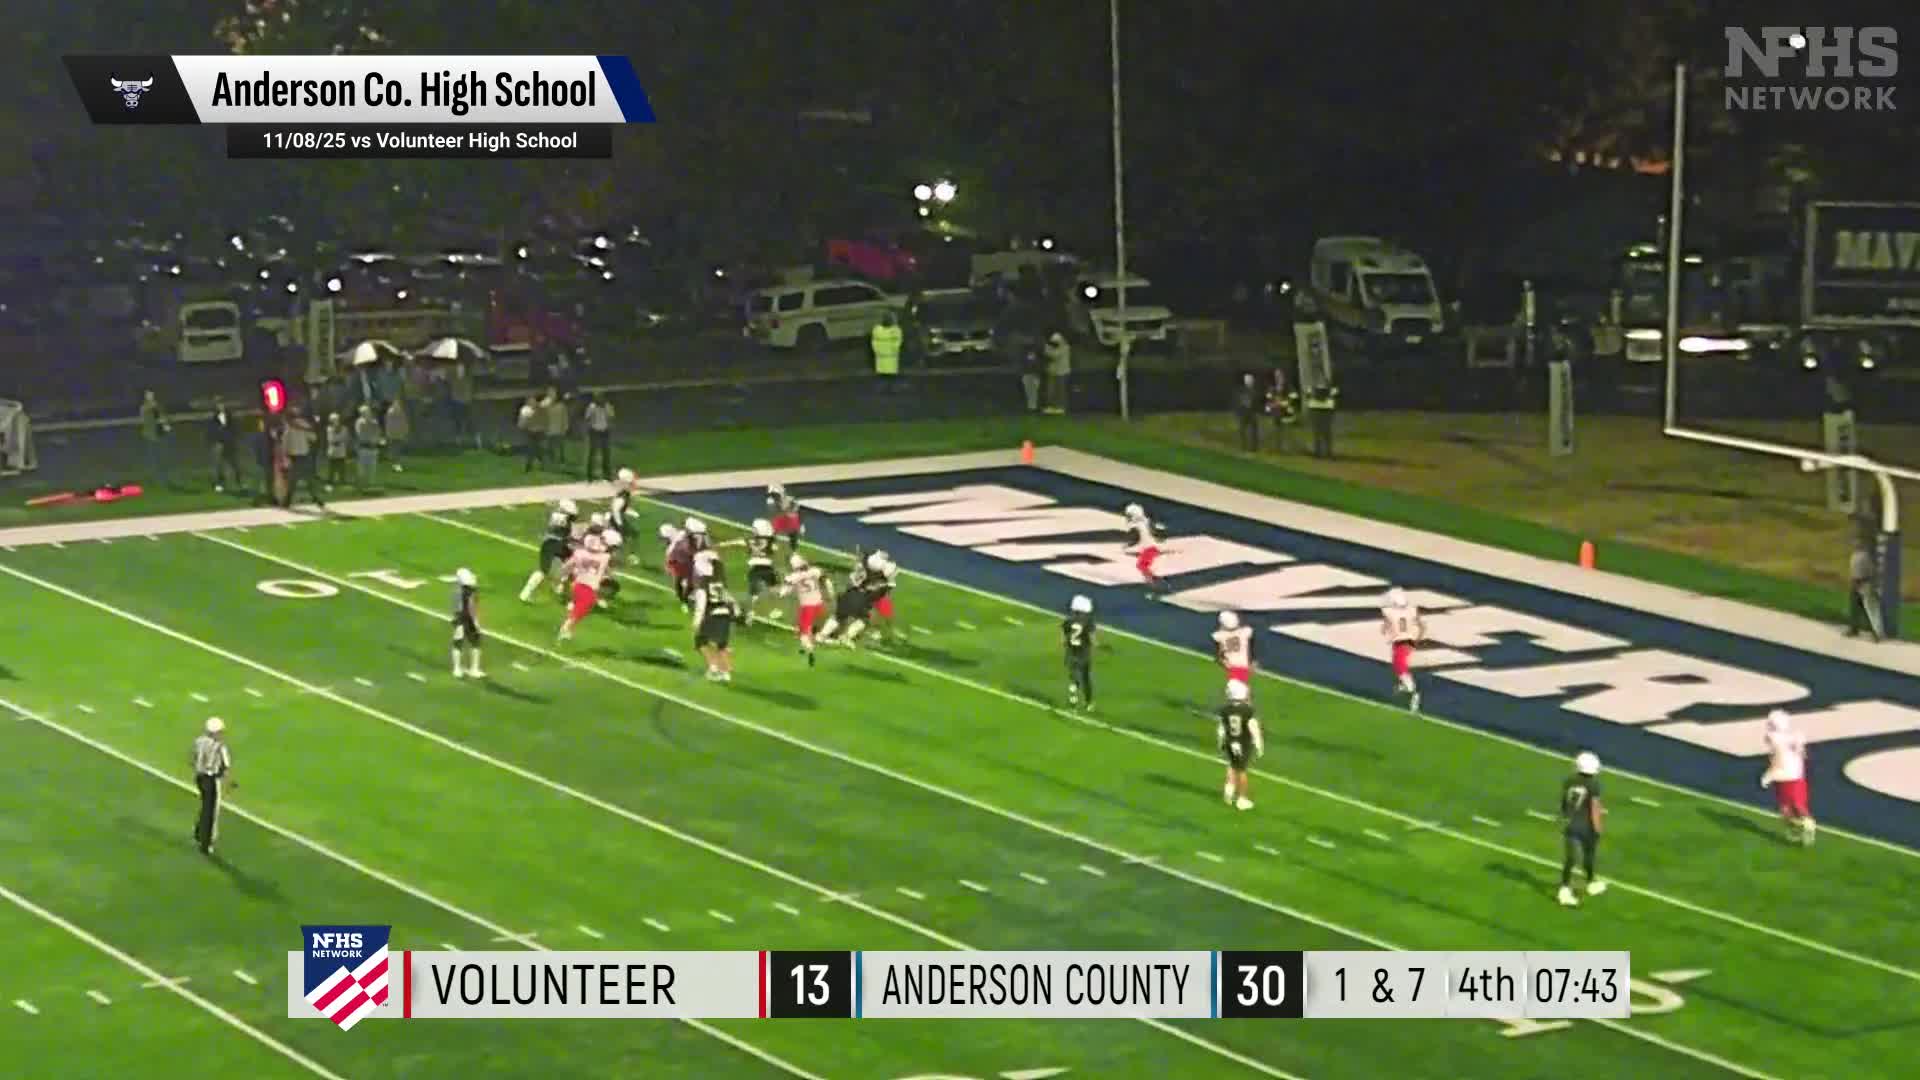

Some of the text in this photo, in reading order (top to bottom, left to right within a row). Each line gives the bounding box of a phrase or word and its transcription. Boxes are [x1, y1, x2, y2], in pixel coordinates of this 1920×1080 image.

[1835, 231, 1920, 269] MAV
[796, 484, 1920, 803] MAVERI
[1070, 622, 1083, 646] 2
